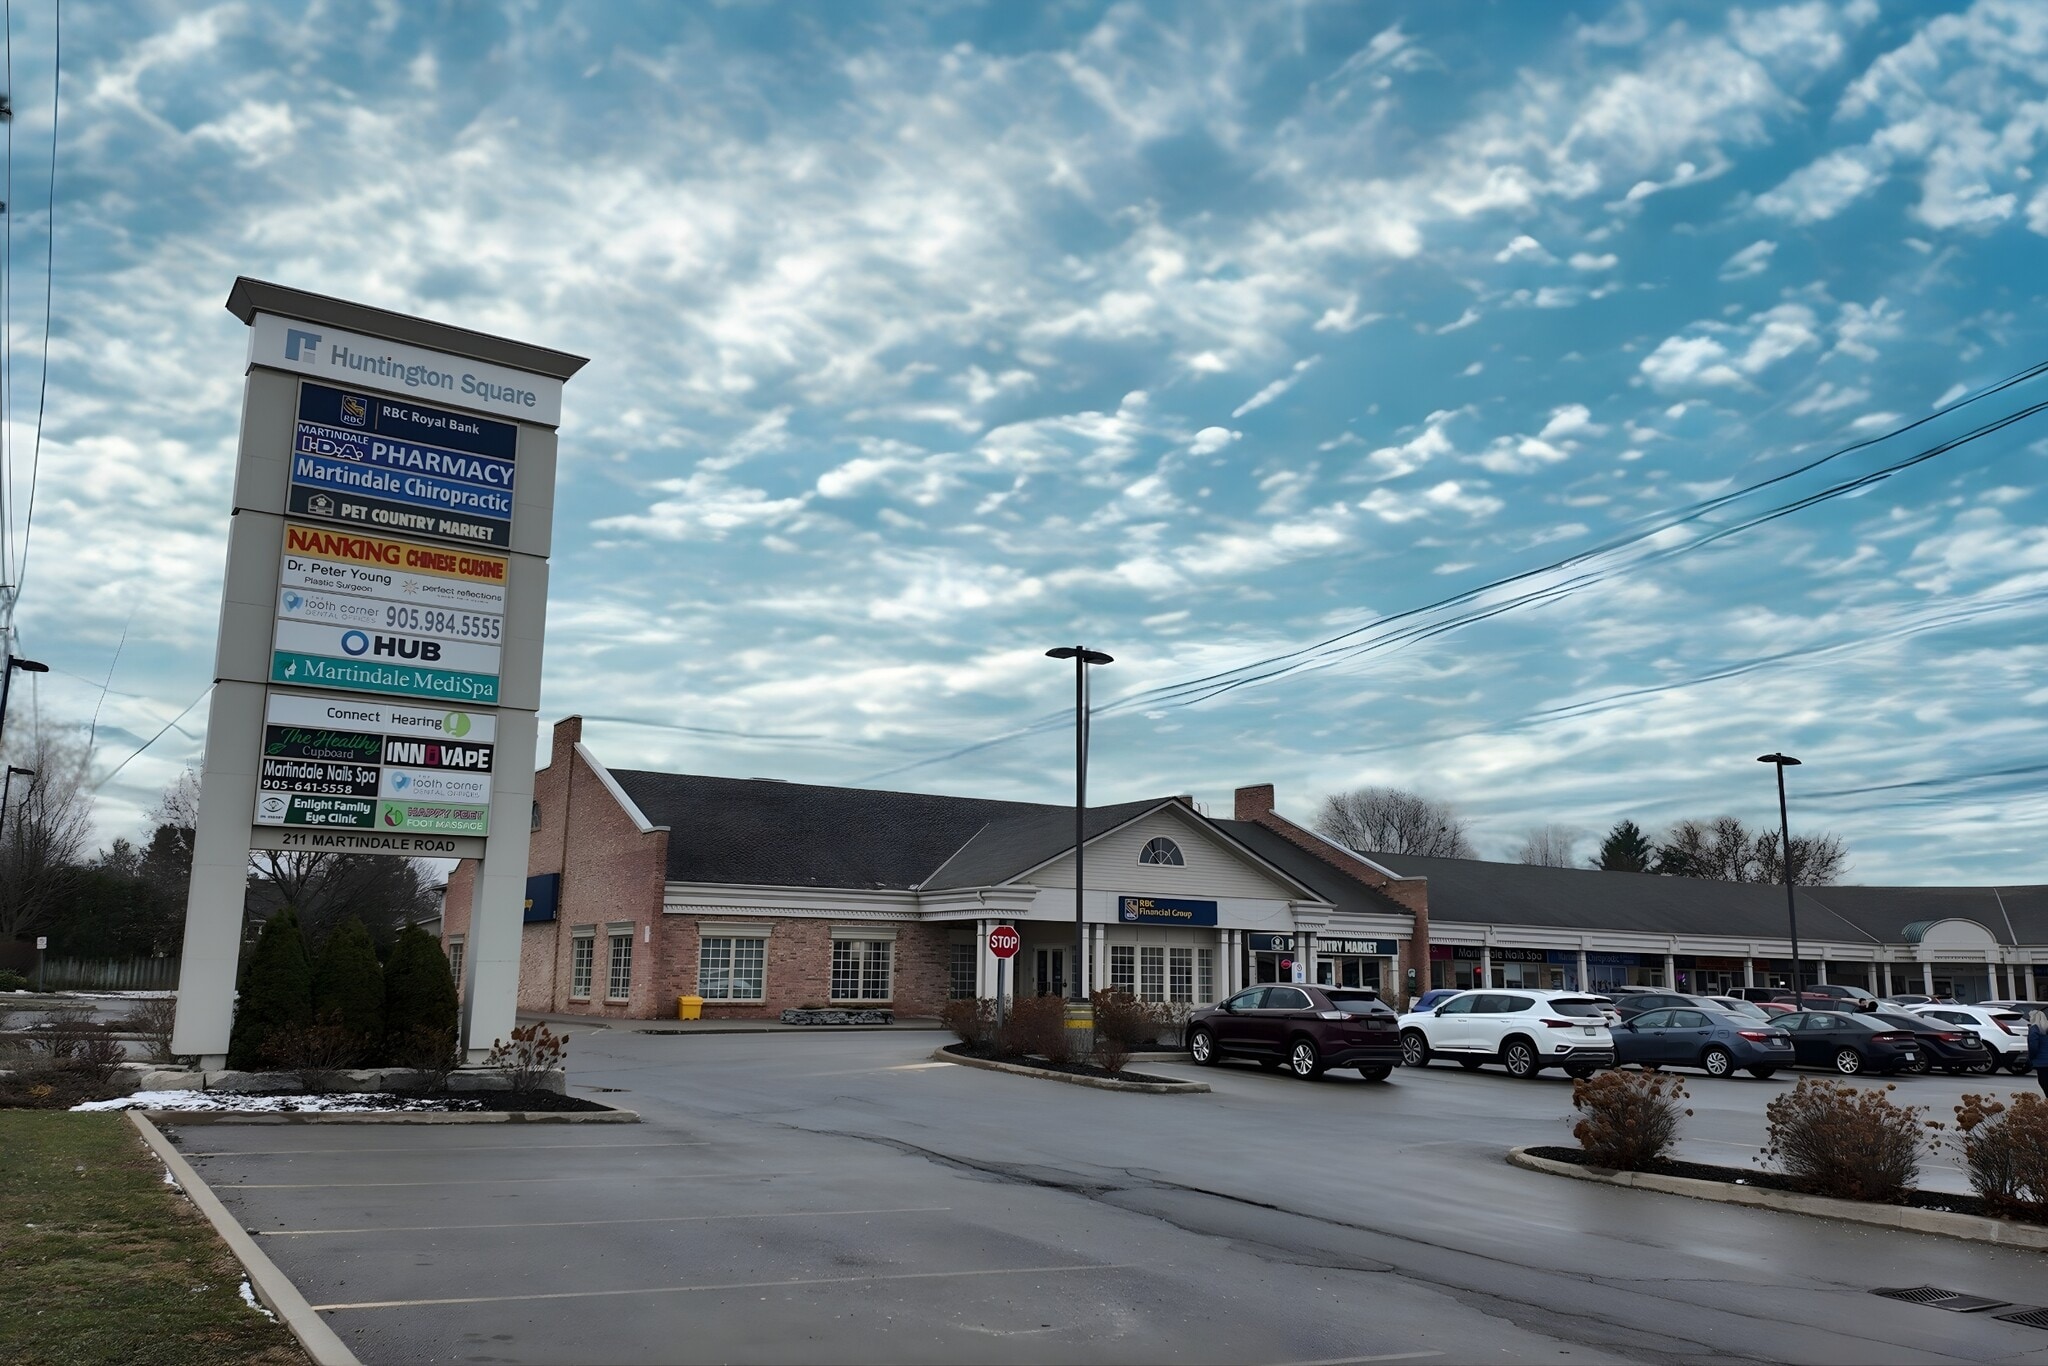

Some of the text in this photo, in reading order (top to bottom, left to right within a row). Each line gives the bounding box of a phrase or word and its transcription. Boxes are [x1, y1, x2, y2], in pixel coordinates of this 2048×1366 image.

[331, 345, 536, 407] Huntington Square
[382, 405, 480, 435] RBC Royal Bank
[298, 424, 370, 445] MARTINDALE
[371, 442, 514, 485] PHARMACY
[297, 458, 510, 512] Martindale Chiropractic
[341, 503, 494, 541] PET COUNTRY MARKET
[288, 529, 504, 579] NANKING CHINESE CUISINE
[287, 559, 392, 586] Dr. Peter Young
[304, 576, 373, 592] Plastic Surgeon
[422, 585, 455, 595] perfect
[457, 589, 502, 602] reflections
[305, 599, 379, 617] tooth corner
[305, 609, 338, 620] DENTAL
[386, 606, 500, 639] 905.984.5555
[373, 635, 441, 661] HUB
[303, 660, 494, 698] Martindale MediSpa
[327, 707, 442, 730] Connect Hearing
[281, 728, 380, 755] The Healthy
[302, 746, 354, 759] Cupboard
[386, 741, 490, 768] INNOVAPE
[264, 760, 376, 786] Martindale Nails Spa
[263, 779, 352, 794] 905-641-5558
[413, 778, 483, 791] tooth corner
[294, 798, 371, 814] Enlight Family
[305, 812, 357, 824] Eye Clinic
[407, 819, 483, 831] FOOT MASSAGE
[282, 833, 455, 852] 211 MARTINDALE ROAD
[1139, 900, 1155, 908] RBC
[1139, 908, 1171, 917] Financial
[1171, 909, 1193, 919] Group
[991, 935, 1018, 949] STOP
[1317, 939, 1378, 953] UNTRY MARKET
[1505, 950, 1525, 960] Nails
[1526, 951, 1542, 962] Spa
